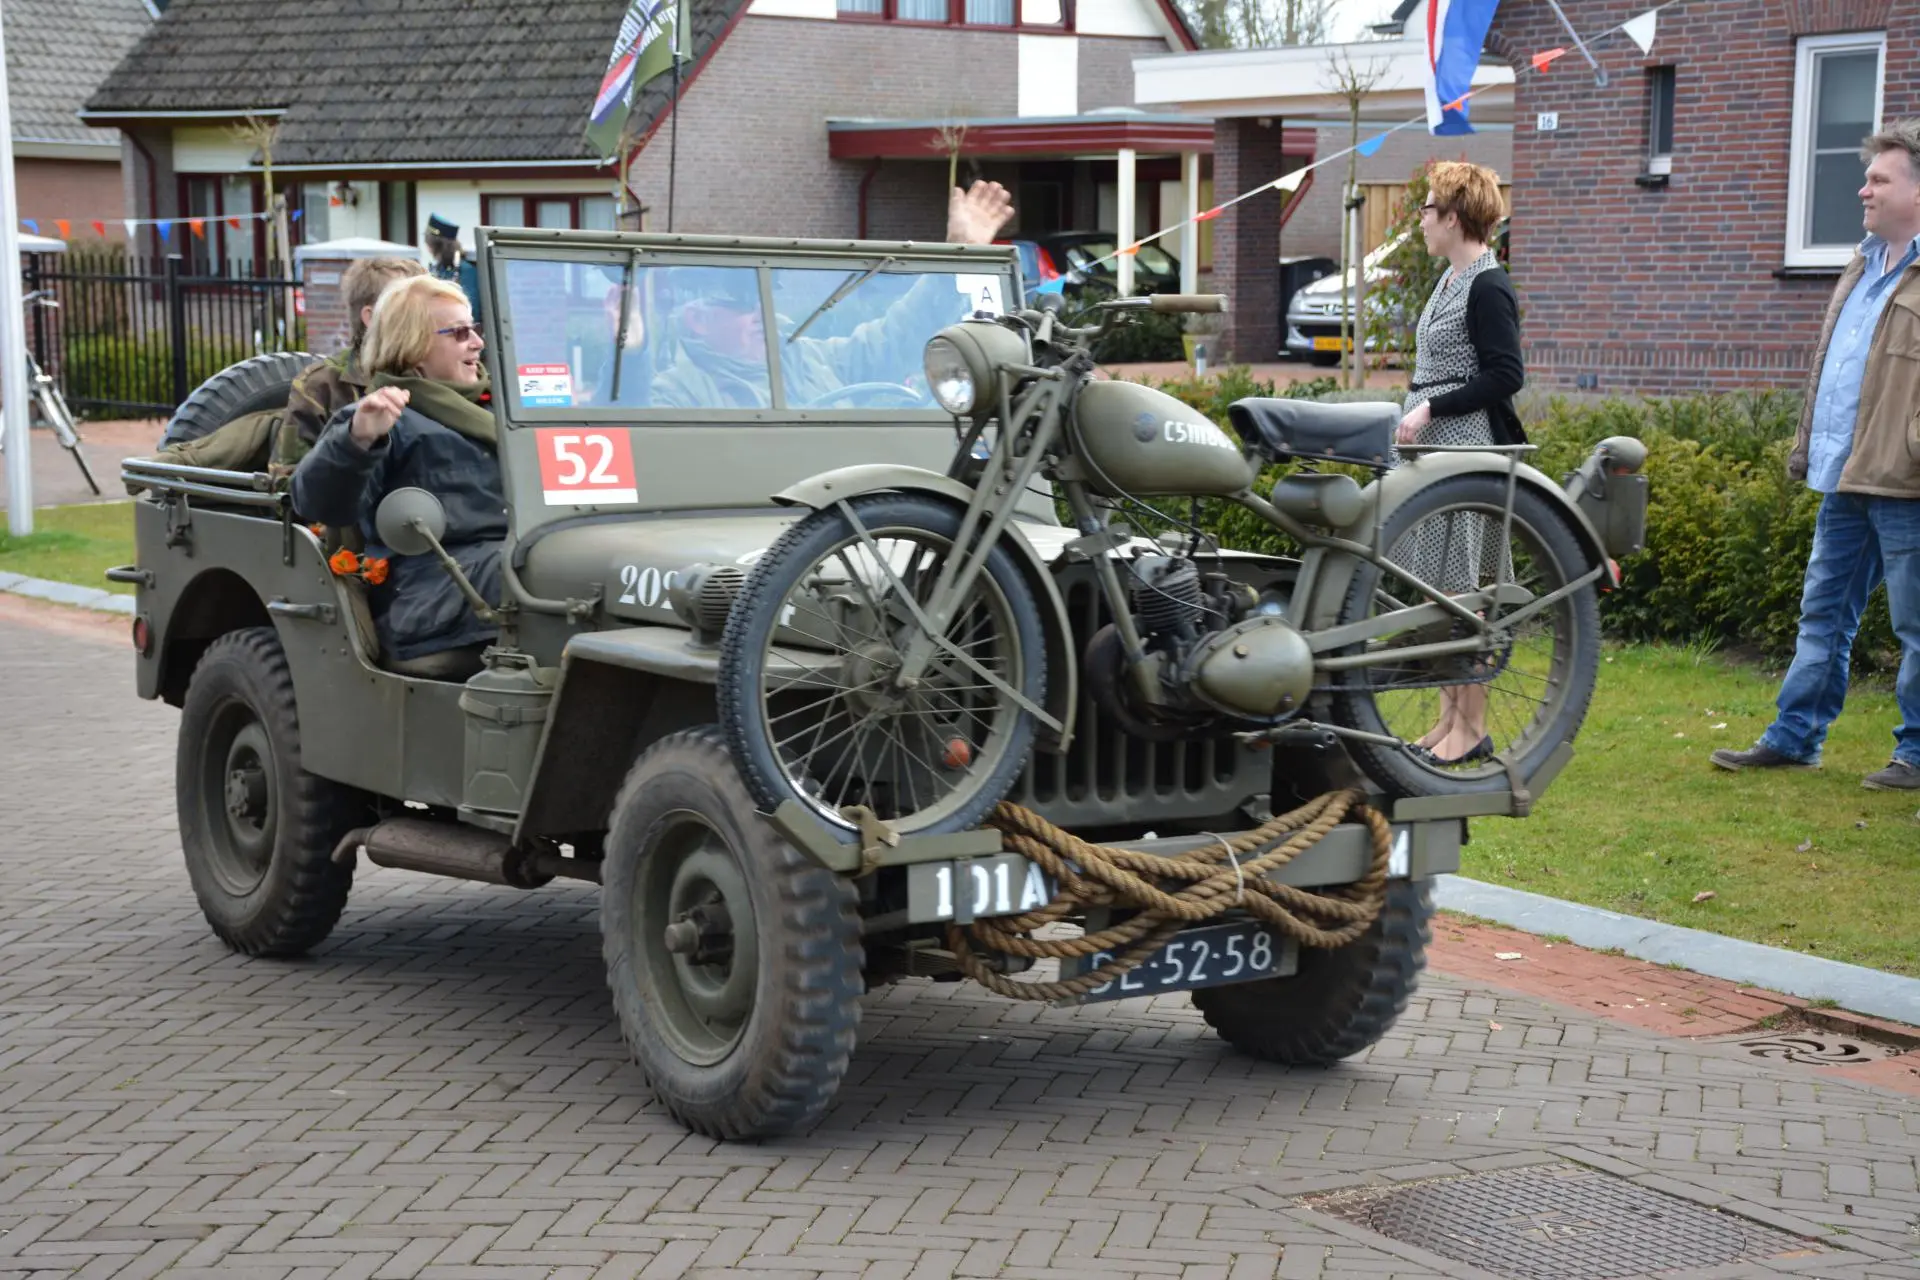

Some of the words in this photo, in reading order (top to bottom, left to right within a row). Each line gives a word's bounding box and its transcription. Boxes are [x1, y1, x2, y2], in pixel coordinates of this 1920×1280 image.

[1542, 116, 1553, 128] 16
[981, 286, 994, 303] A
[553, 434, 619, 485] 52
